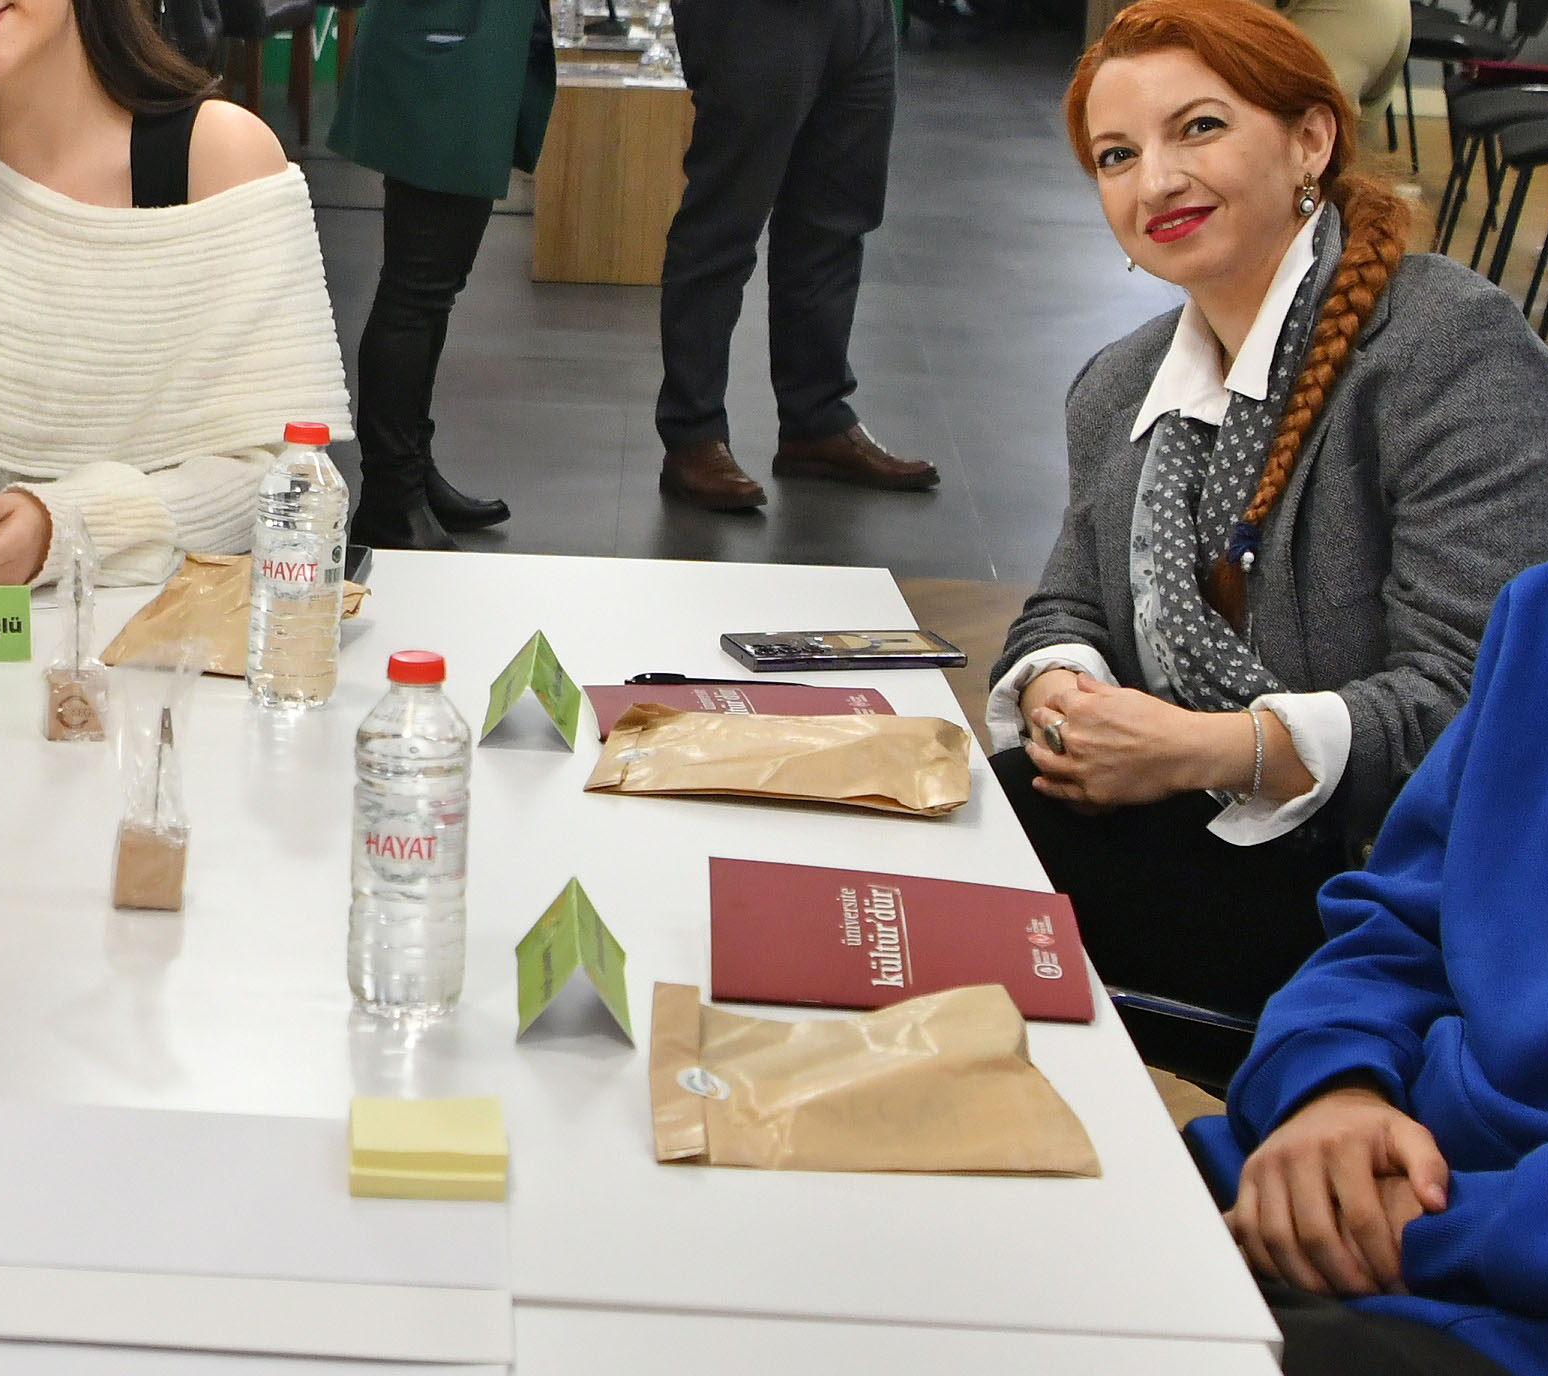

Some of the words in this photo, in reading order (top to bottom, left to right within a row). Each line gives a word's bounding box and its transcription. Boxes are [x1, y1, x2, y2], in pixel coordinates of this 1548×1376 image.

[262, 559, 318, 583] HAYAT
[365, 831, 439, 860] HAYAT
[836, 887, 862, 946] üniversite
[864, 889, 905, 988] kültür'dür
